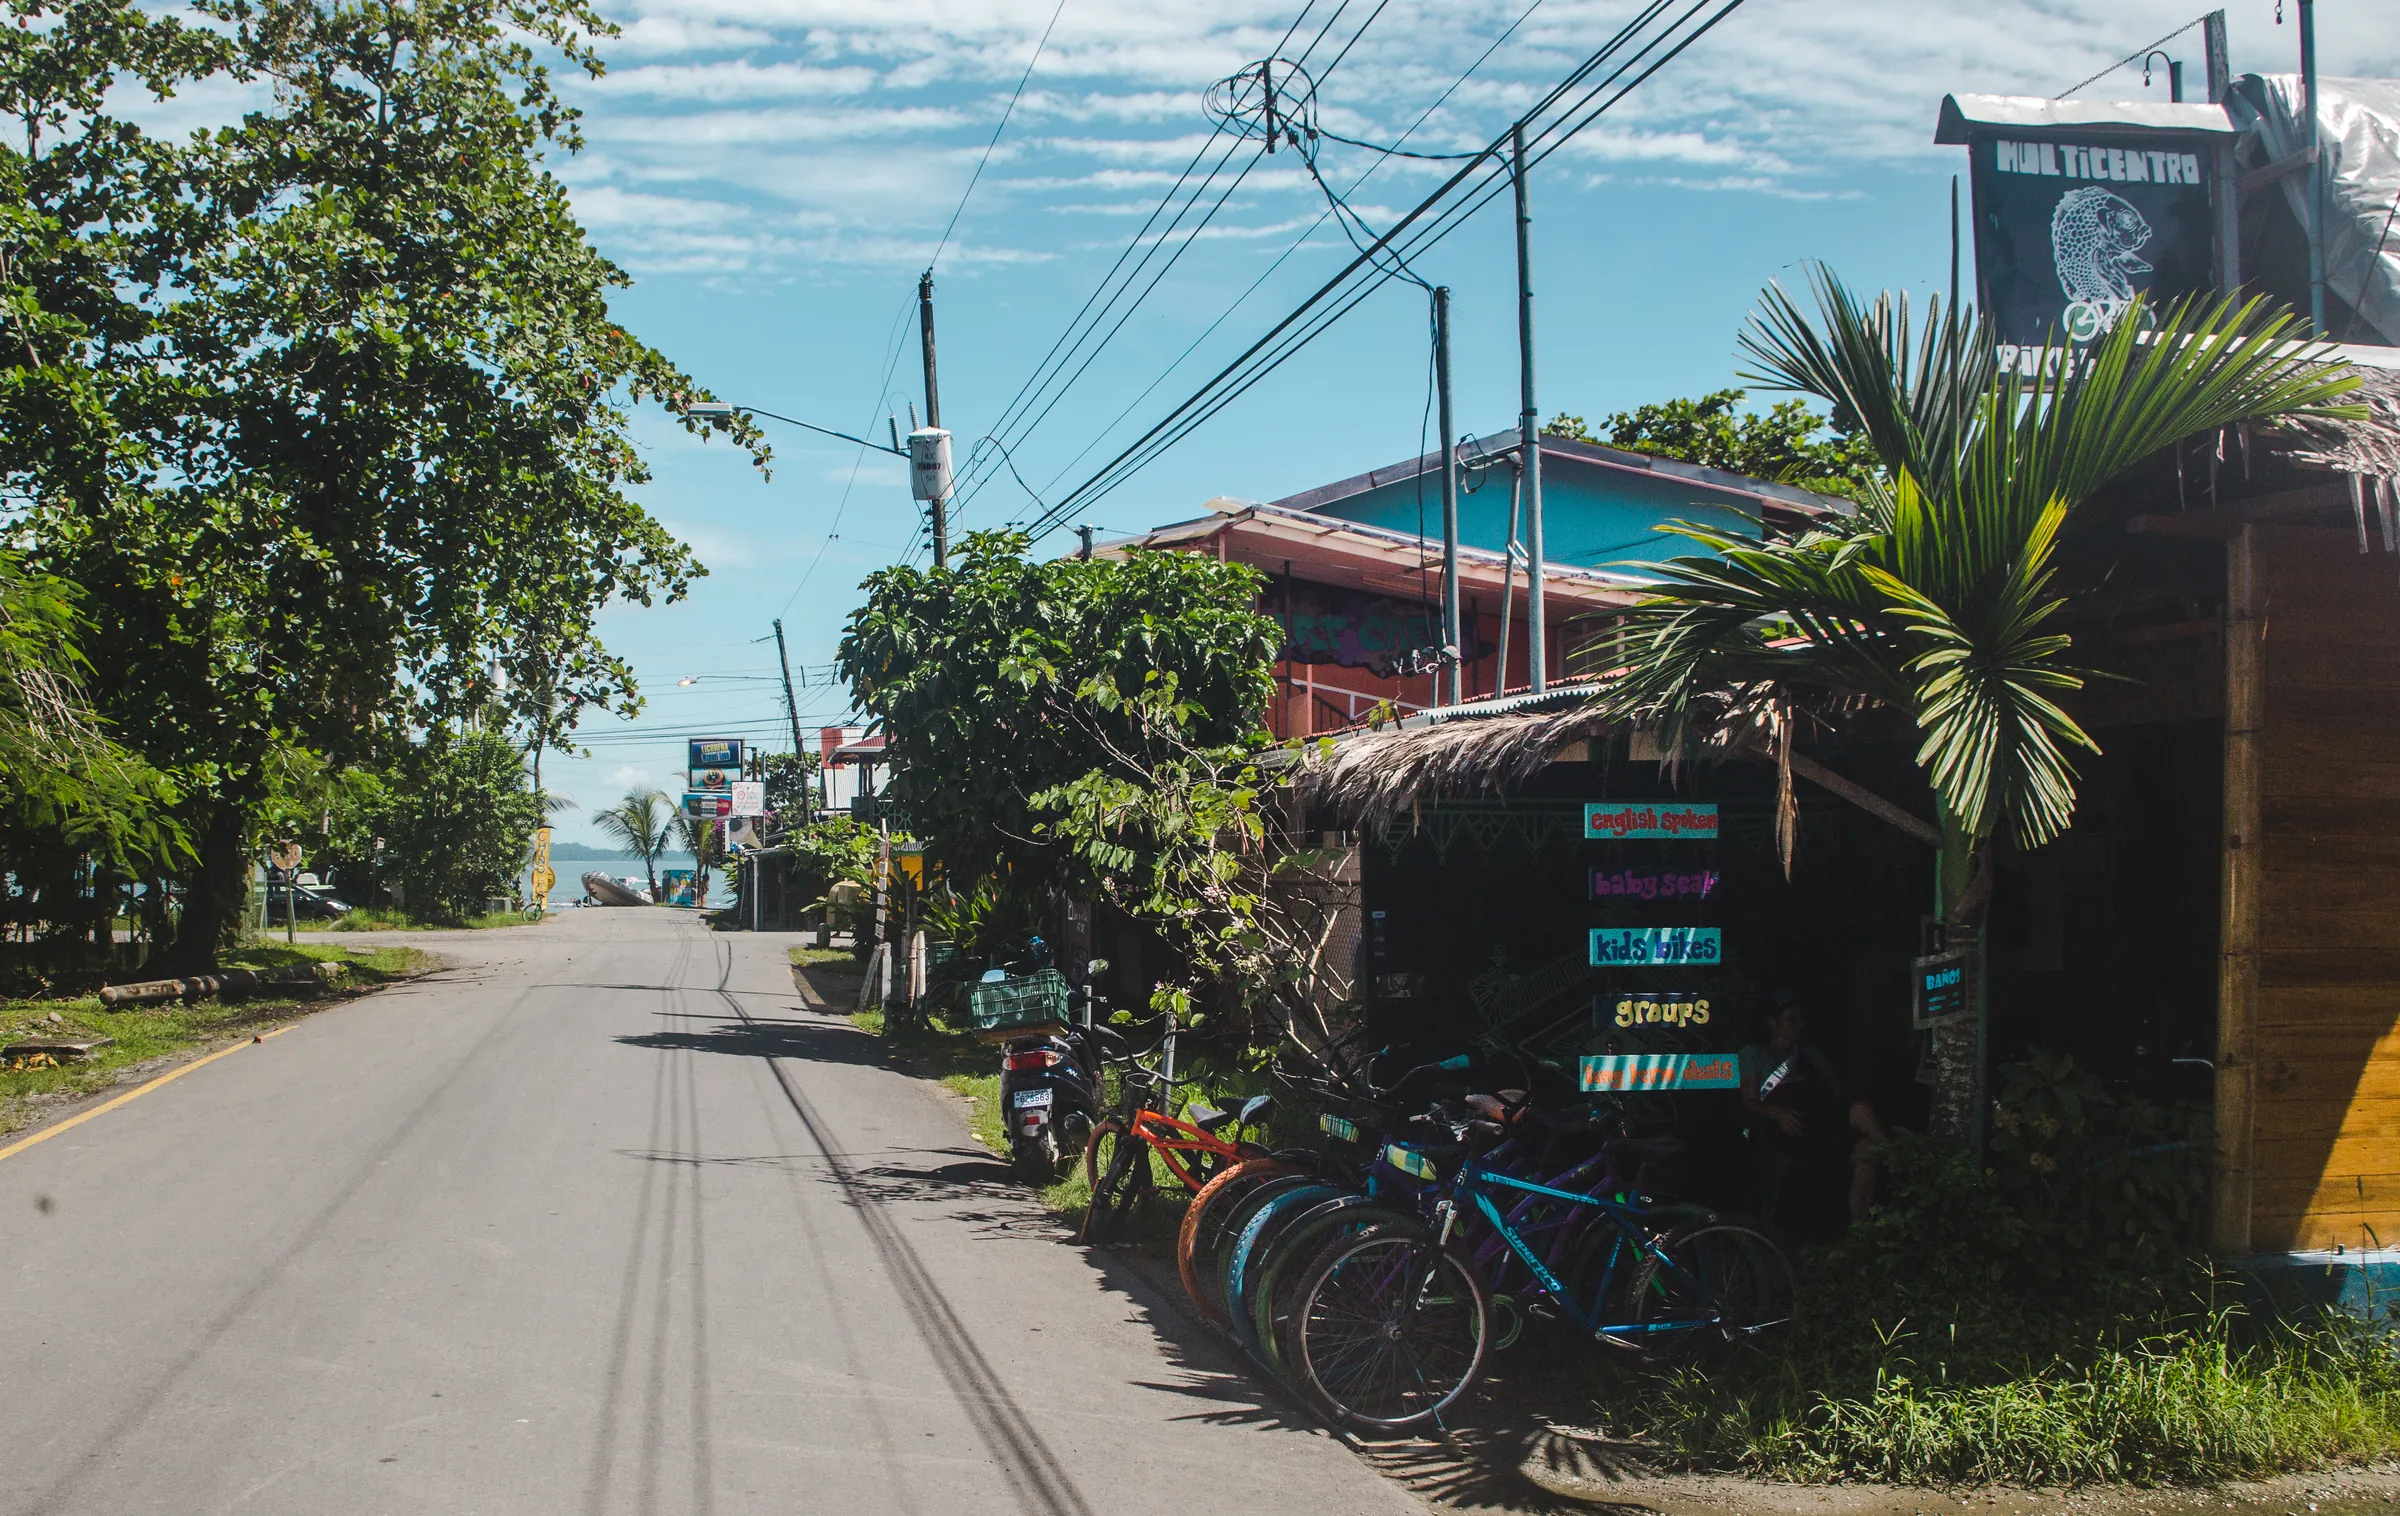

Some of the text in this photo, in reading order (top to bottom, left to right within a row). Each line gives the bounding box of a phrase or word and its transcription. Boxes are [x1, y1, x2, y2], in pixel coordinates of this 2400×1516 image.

[1591, 808, 1718, 836] english spoken
[538, 831, 547, 874] CHINO
[1595, 869, 1657, 900] baby
[1597, 931, 1717, 961] kids bikes
[1615, 999, 1710, 1028] groups
[1585, 1064, 1624, 1089] long
[1683, 1060, 1734, 1081] deals
